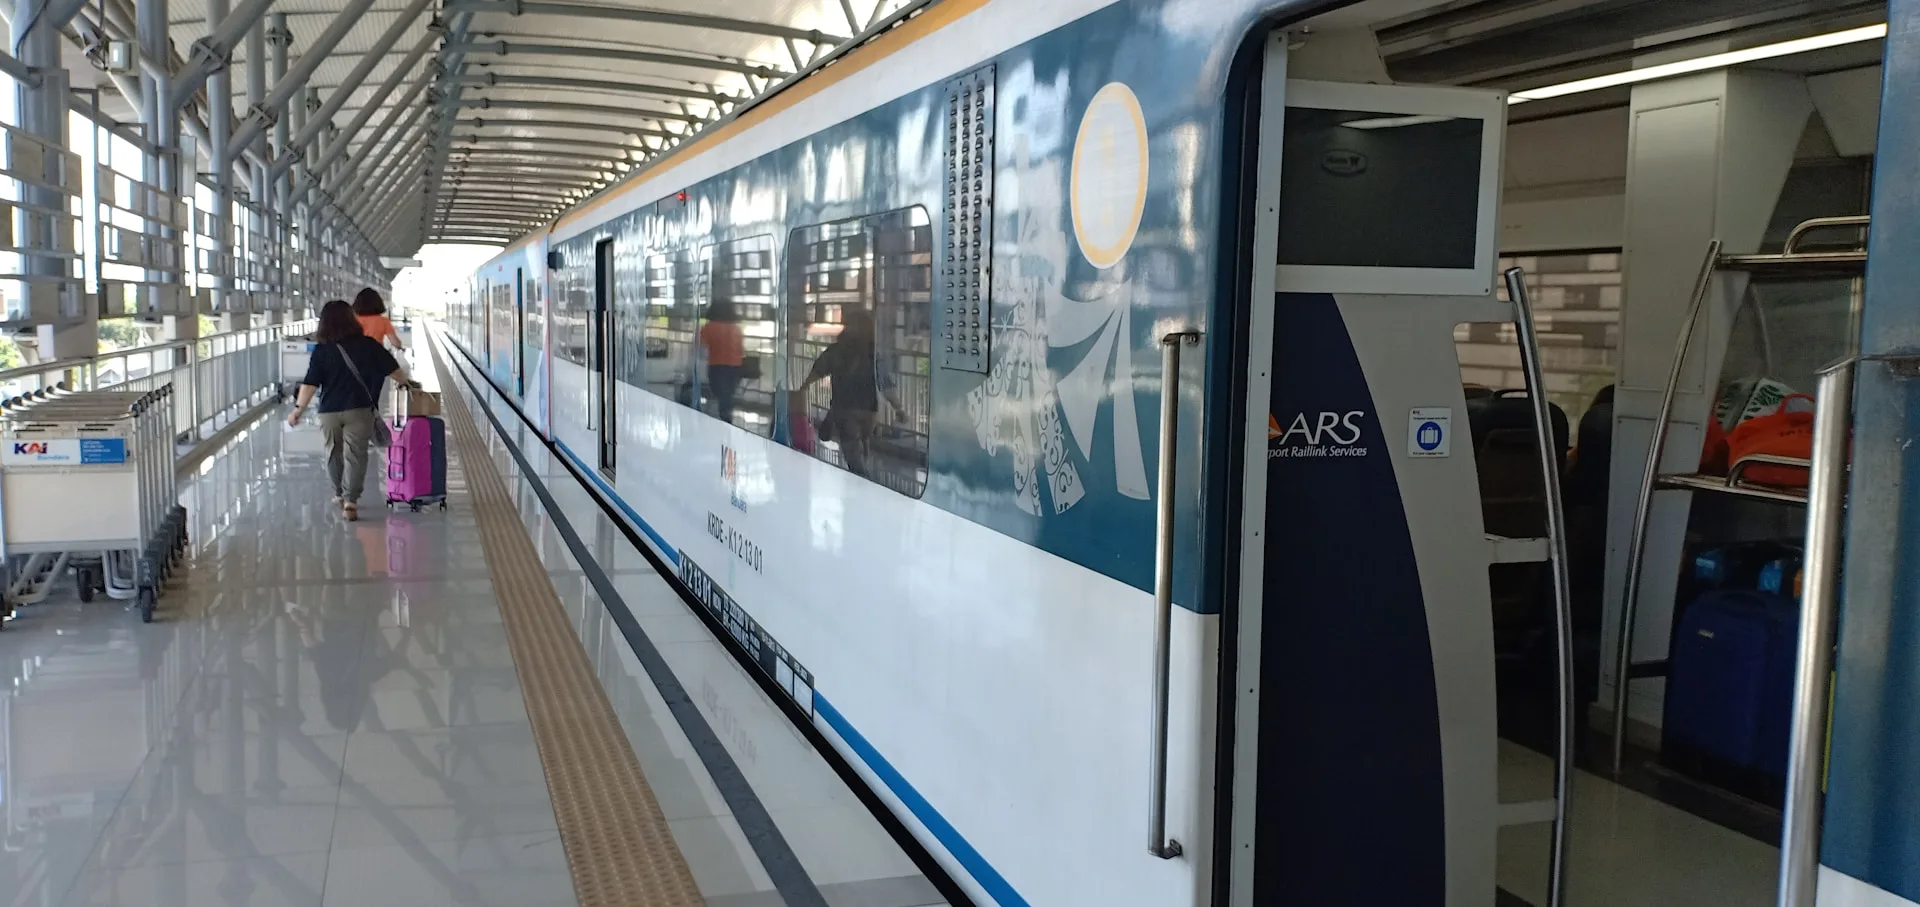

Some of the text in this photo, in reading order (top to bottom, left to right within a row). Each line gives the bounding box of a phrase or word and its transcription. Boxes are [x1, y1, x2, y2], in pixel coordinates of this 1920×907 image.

[1279, 410, 1365, 445] ARS
[1291, 445, 1328, 458] Raillink
[1329, 445, 1368, 457] Services
[707, 510, 724, 543] KRDE
[728, 525, 737, 554] K1
[738, 533, 743, 559] 2
[744, 538, 753, 566] 13
[754, 545, 763, 576] 01
[679, 551, 711, 608] K1 2 13 01
